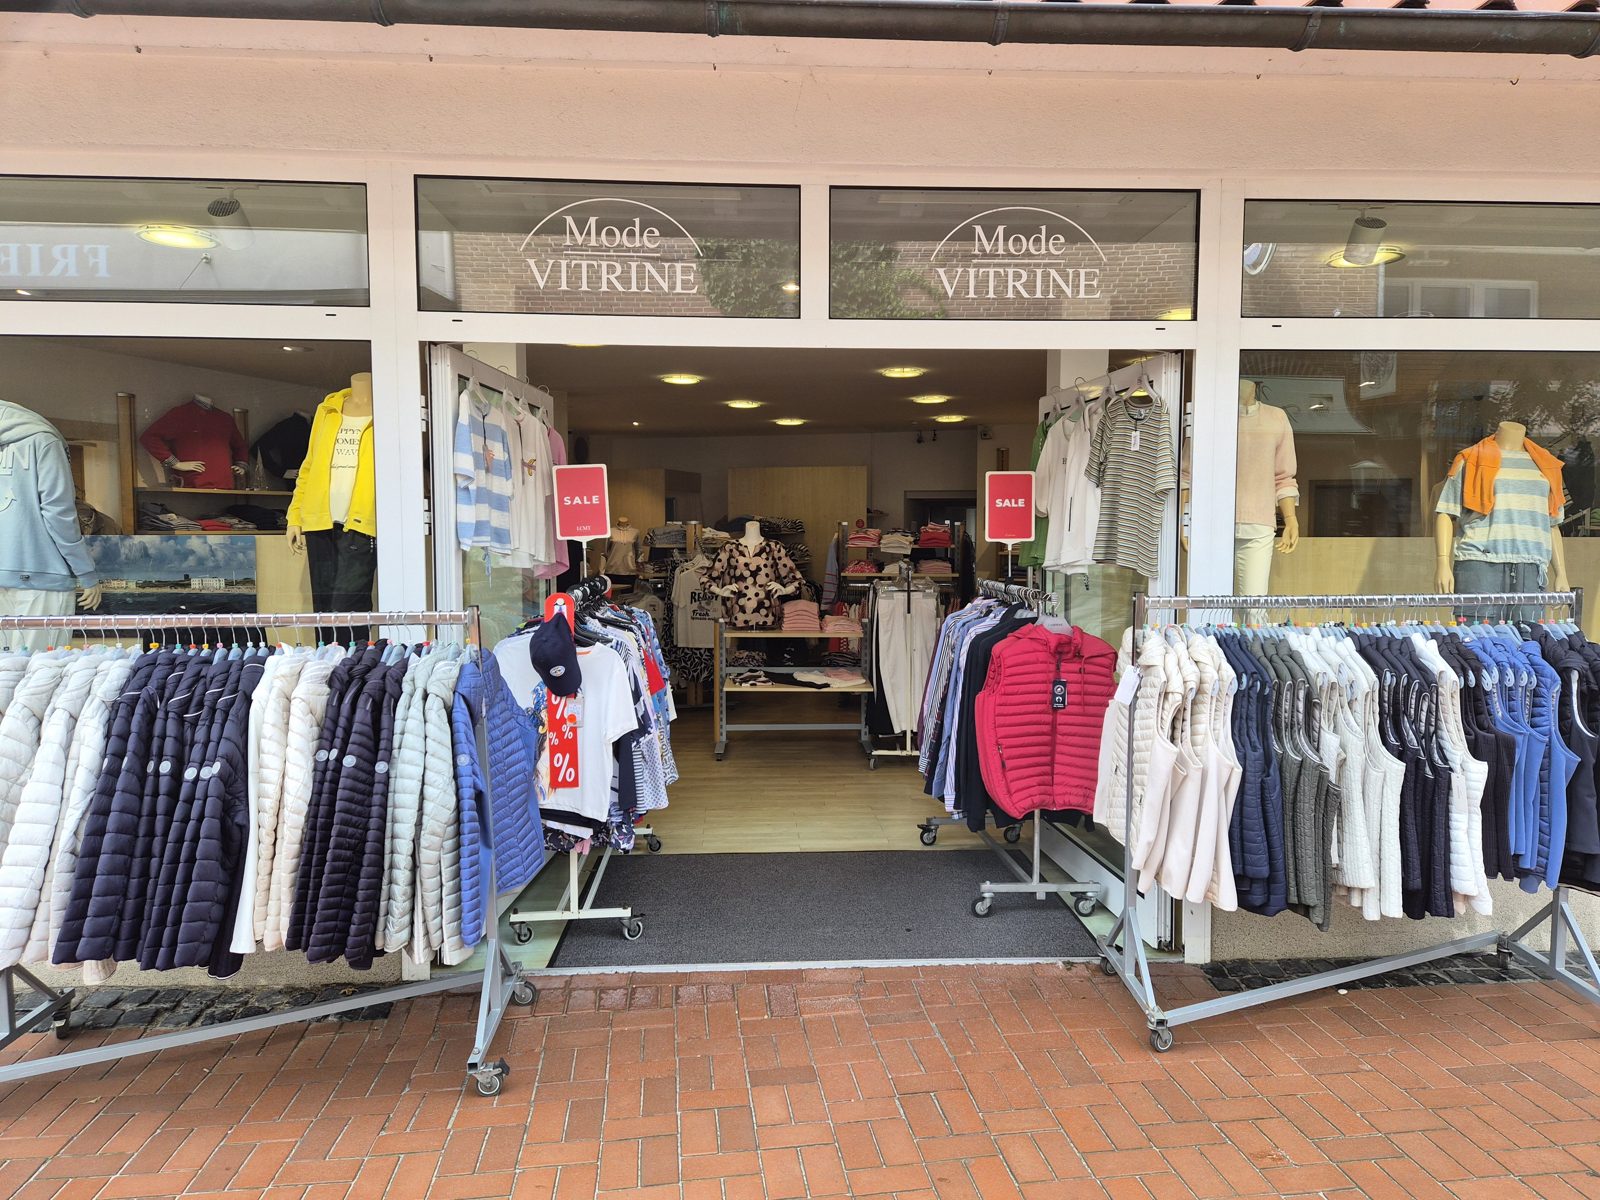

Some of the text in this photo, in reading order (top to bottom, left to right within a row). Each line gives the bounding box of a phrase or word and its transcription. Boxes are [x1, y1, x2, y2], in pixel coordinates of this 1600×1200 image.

[562, 215, 661, 248] Mode
[972, 224, 1067, 255] Mode
[526, 259, 699, 294] VITRINE
[936, 268, 1101, 299] VITRINE
[563, 495, 600, 506] SALE
[995, 498, 1025, 508] SALE
[549, 732, 560, 746] %
[562, 724, 573, 740] %
[553, 753, 575, 783] %
